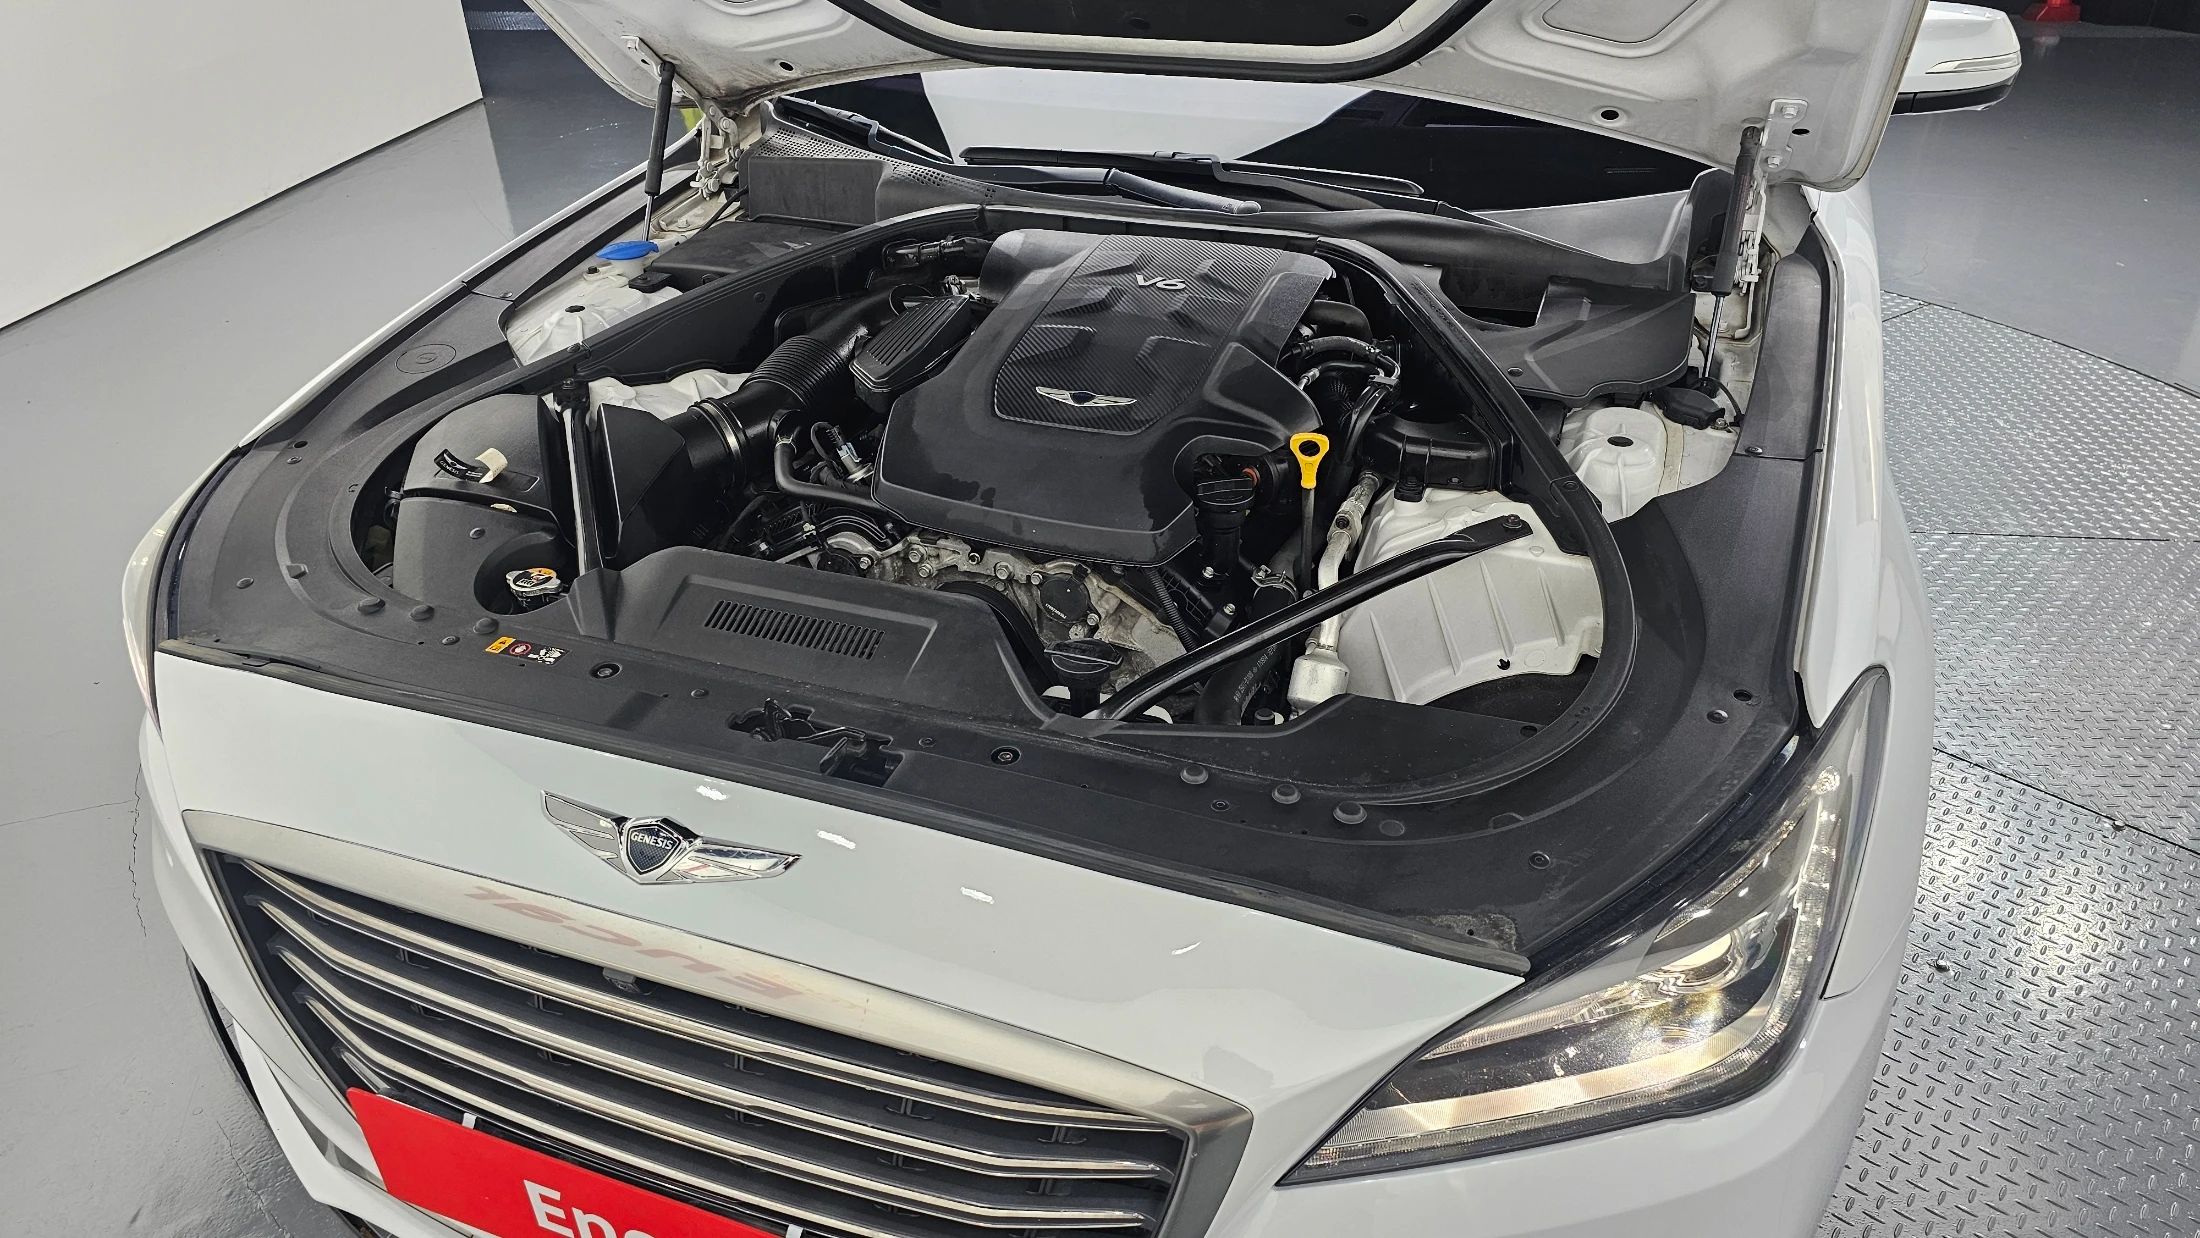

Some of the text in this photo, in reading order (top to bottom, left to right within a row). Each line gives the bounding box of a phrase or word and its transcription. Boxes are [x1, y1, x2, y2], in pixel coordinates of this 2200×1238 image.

[1135, 273, 1187, 291] V6
[439, 460, 459, 475] GENESIS
[630, 831, 674, 850] GENESIS
[523, 1179, 656, 1238] En
